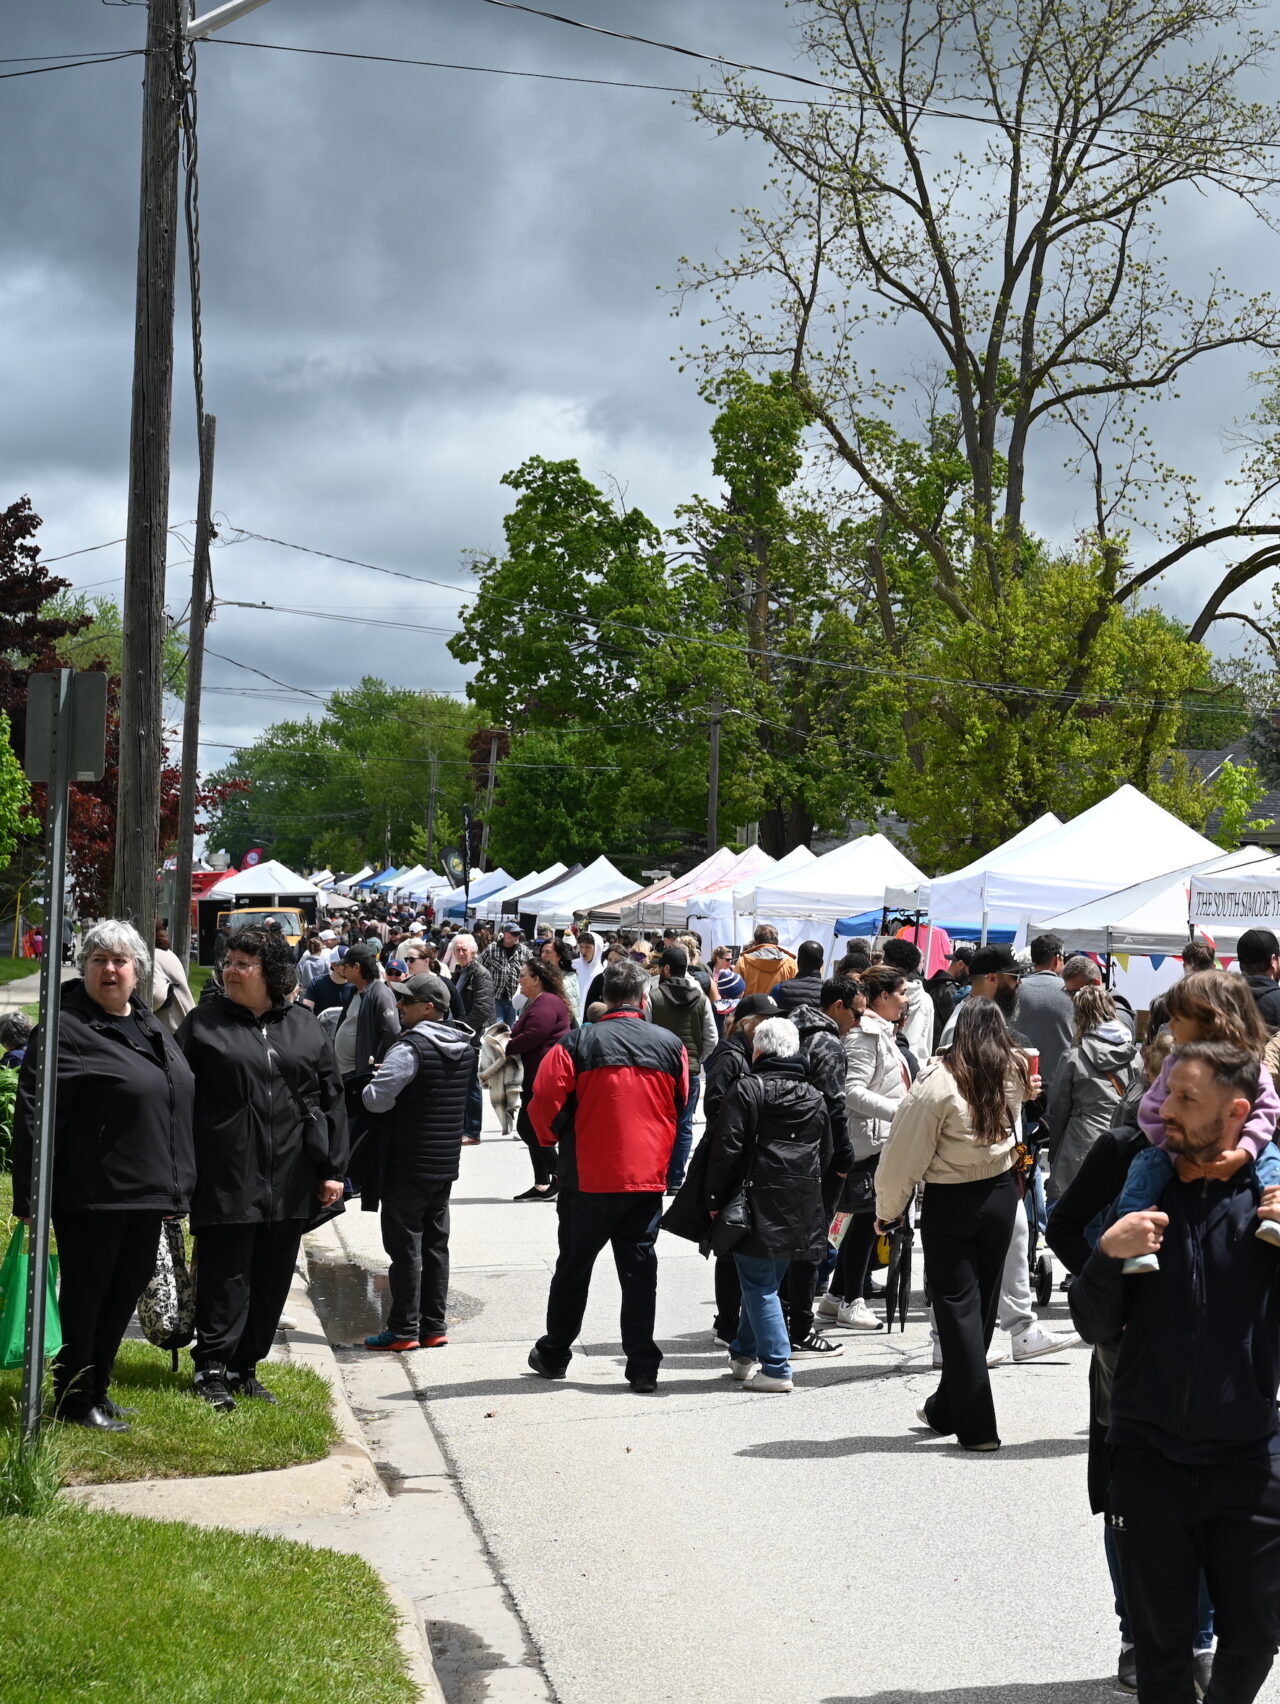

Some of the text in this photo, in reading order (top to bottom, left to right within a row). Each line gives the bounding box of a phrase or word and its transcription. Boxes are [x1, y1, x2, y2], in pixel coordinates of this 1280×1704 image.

[1196, 892, 1212, 916] THE
[1212, 892, 1242, 917] SOUTH
[1240, 891, 1271, 917] SIMCOE
